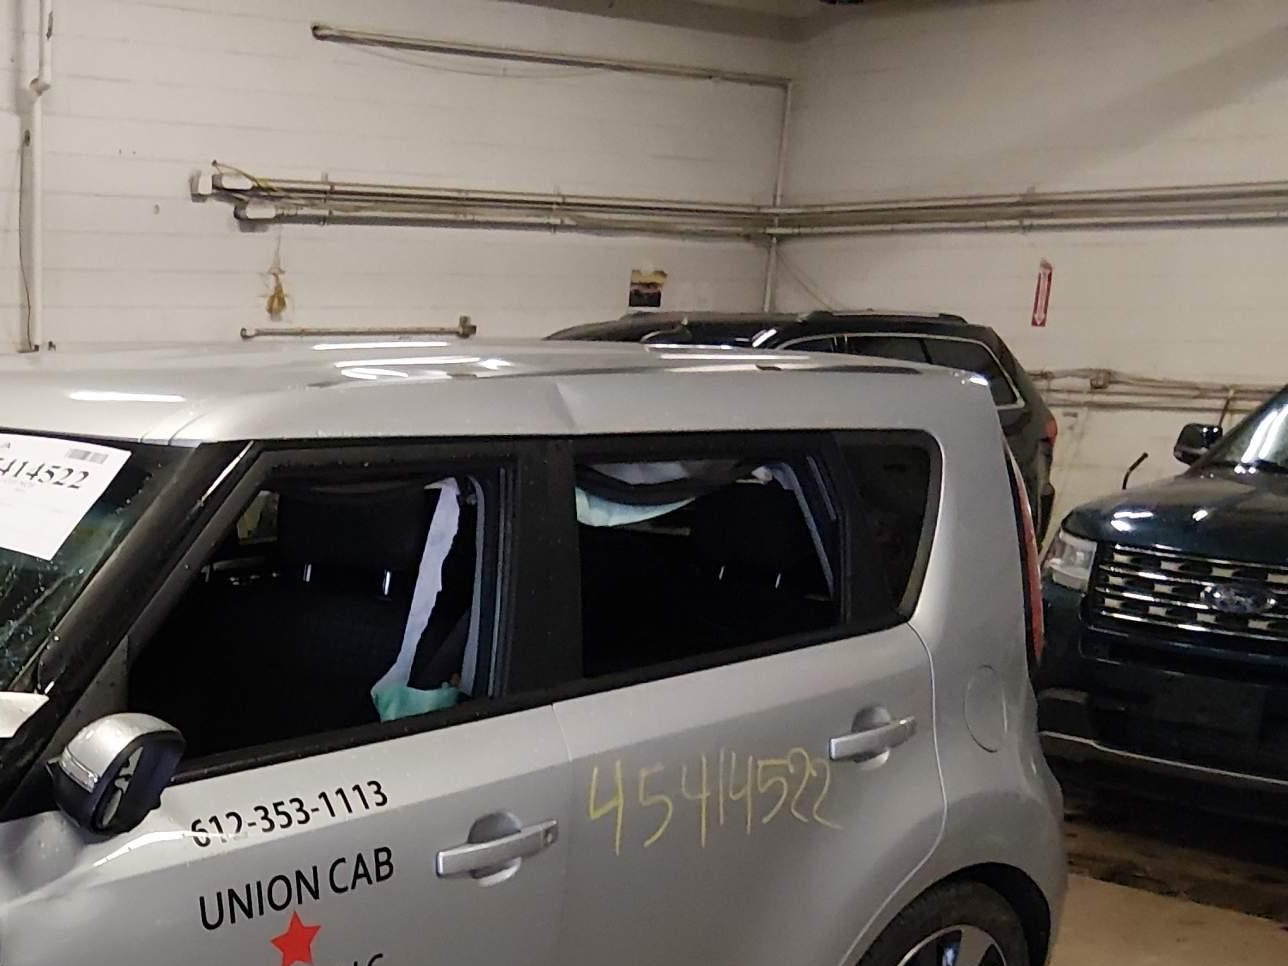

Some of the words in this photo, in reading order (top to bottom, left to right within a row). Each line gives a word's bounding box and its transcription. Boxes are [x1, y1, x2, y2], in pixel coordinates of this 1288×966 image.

[190, 780, 388, 848] 612-353-1113
[587, 747, 843, 856] 45414522
[199, 865, 320, 931] UNION
[329, 846, 394, 894] CAB
